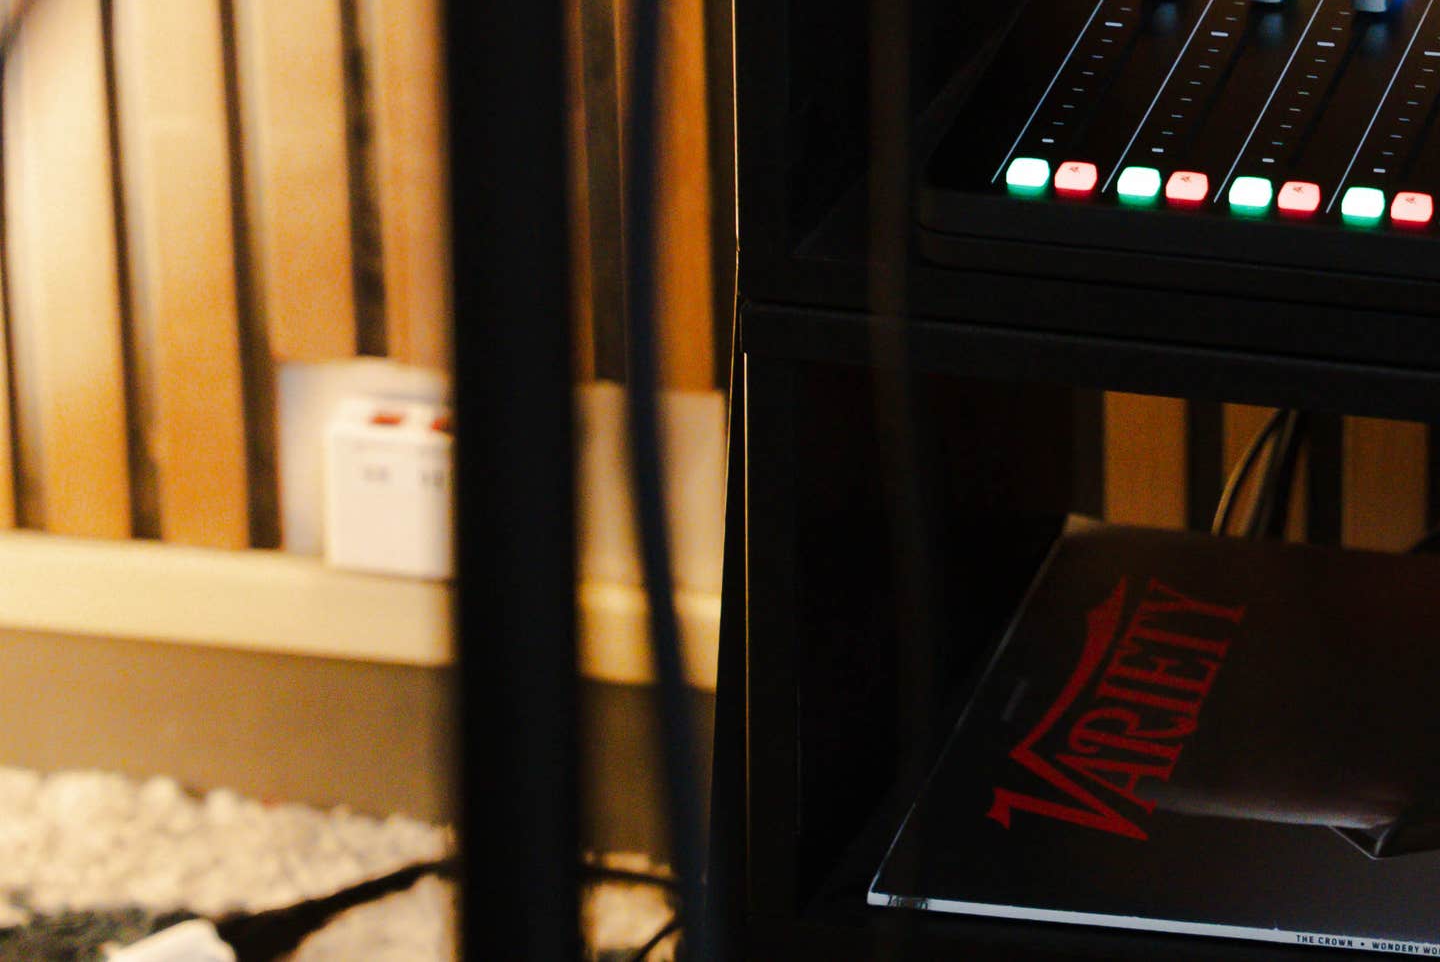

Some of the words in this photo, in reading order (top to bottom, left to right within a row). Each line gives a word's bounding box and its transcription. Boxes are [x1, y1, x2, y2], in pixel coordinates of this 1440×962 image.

[986, 576, 1246, 840] VARIETY
[1296, 934, 1315, 944] THE
[1318, 936, 1353, 948] CROWN
[1371, 941, 1420, 954] WONDERY
